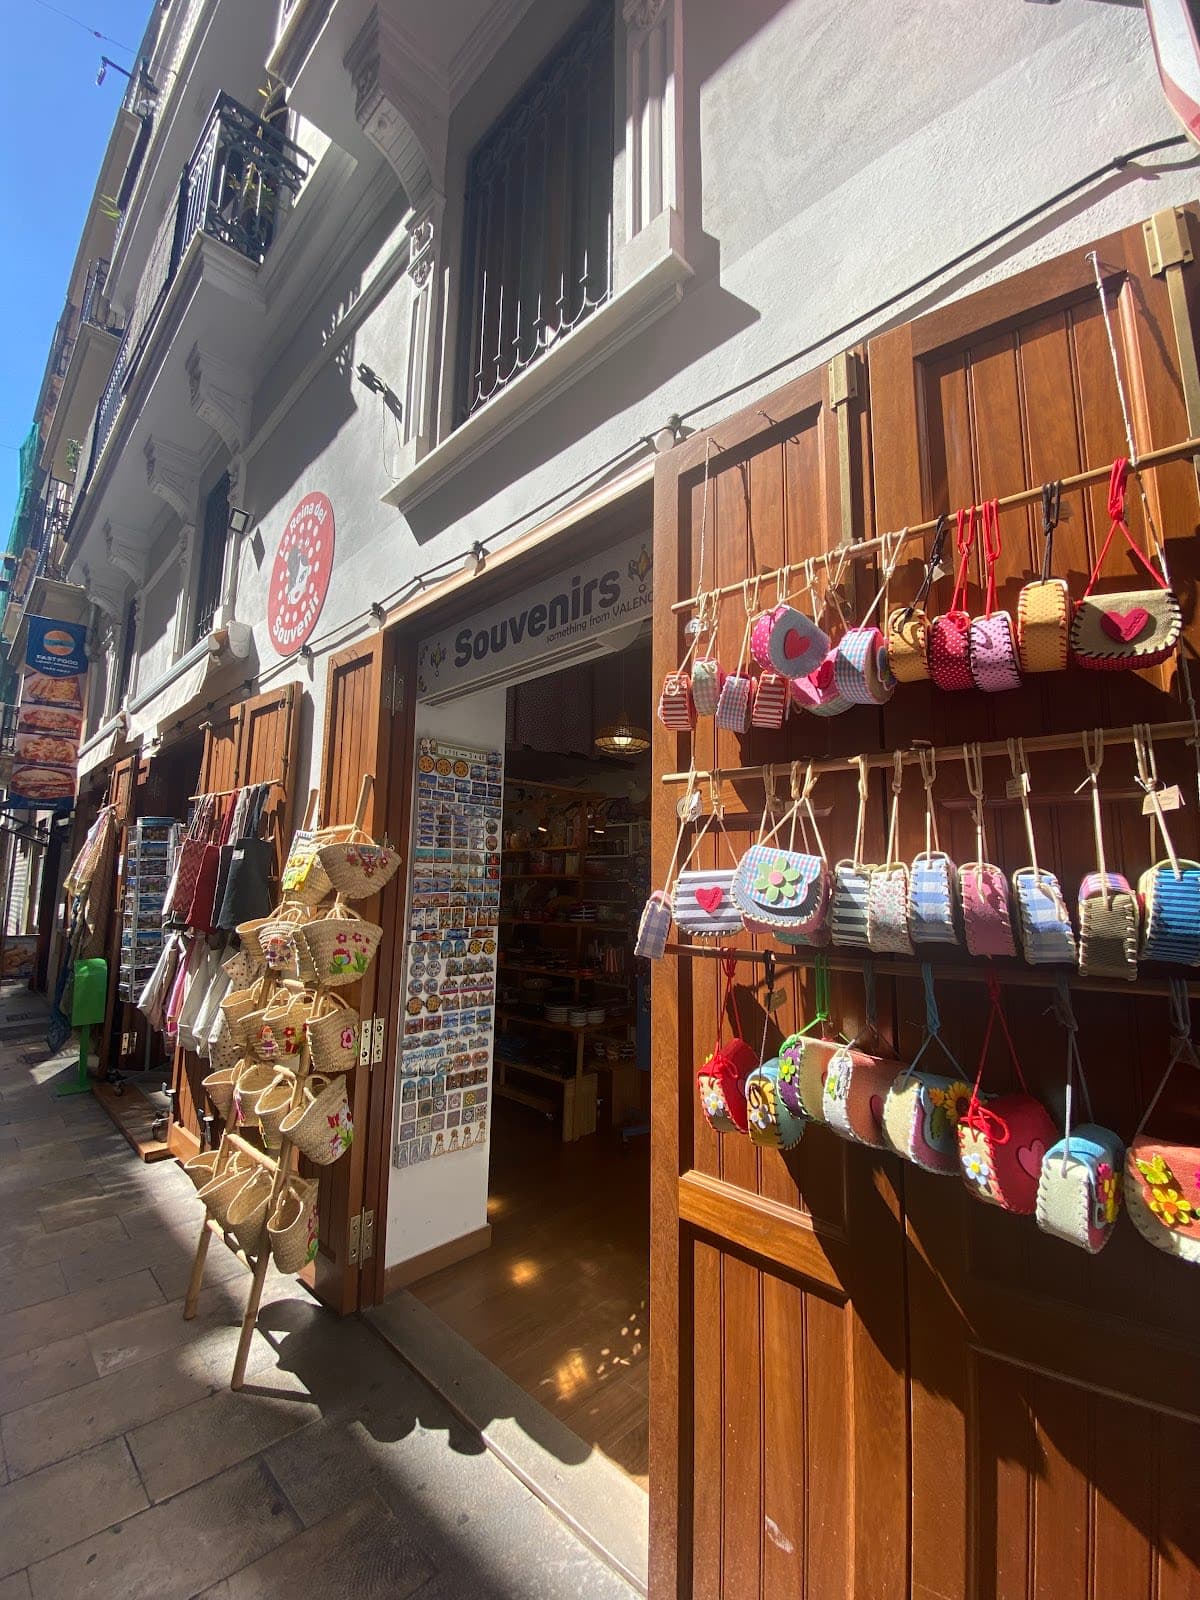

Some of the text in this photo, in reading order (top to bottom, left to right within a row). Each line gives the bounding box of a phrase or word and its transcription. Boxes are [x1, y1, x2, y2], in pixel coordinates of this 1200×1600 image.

[279, 500, 328, 558] La Reina del
[272, 592, 320, 645] Souvenir
[454, 569, 621, 668] Souvenirs
[546, 621, 588, 644] something
[589, 612, 611, 628] from
[36, 654, 57, 662] FAST
[57, 657, 79, 666] FOOD
